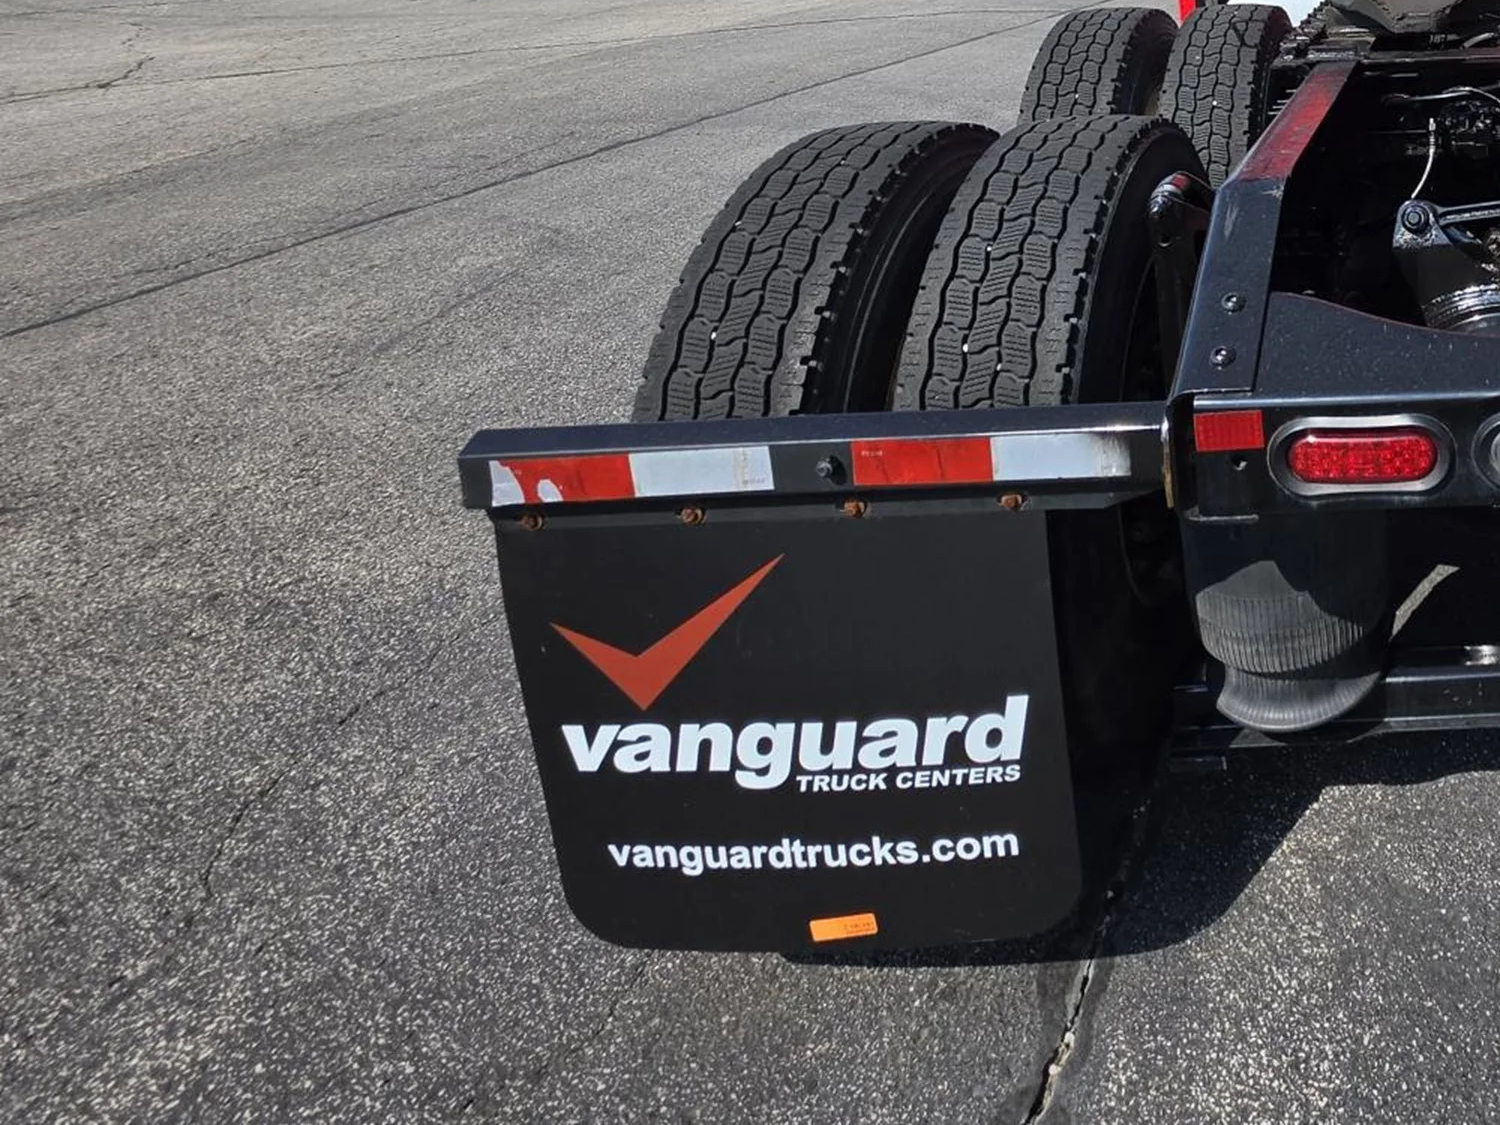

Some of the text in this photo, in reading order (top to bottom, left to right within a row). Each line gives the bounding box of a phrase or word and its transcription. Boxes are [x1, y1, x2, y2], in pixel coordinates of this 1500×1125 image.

[562, 694, 1030, 789] vanguard
[796, 765, 1021, 792] TRUCK CENTERS
[608, 834, 1019, 877] vanguardtrucks.com
